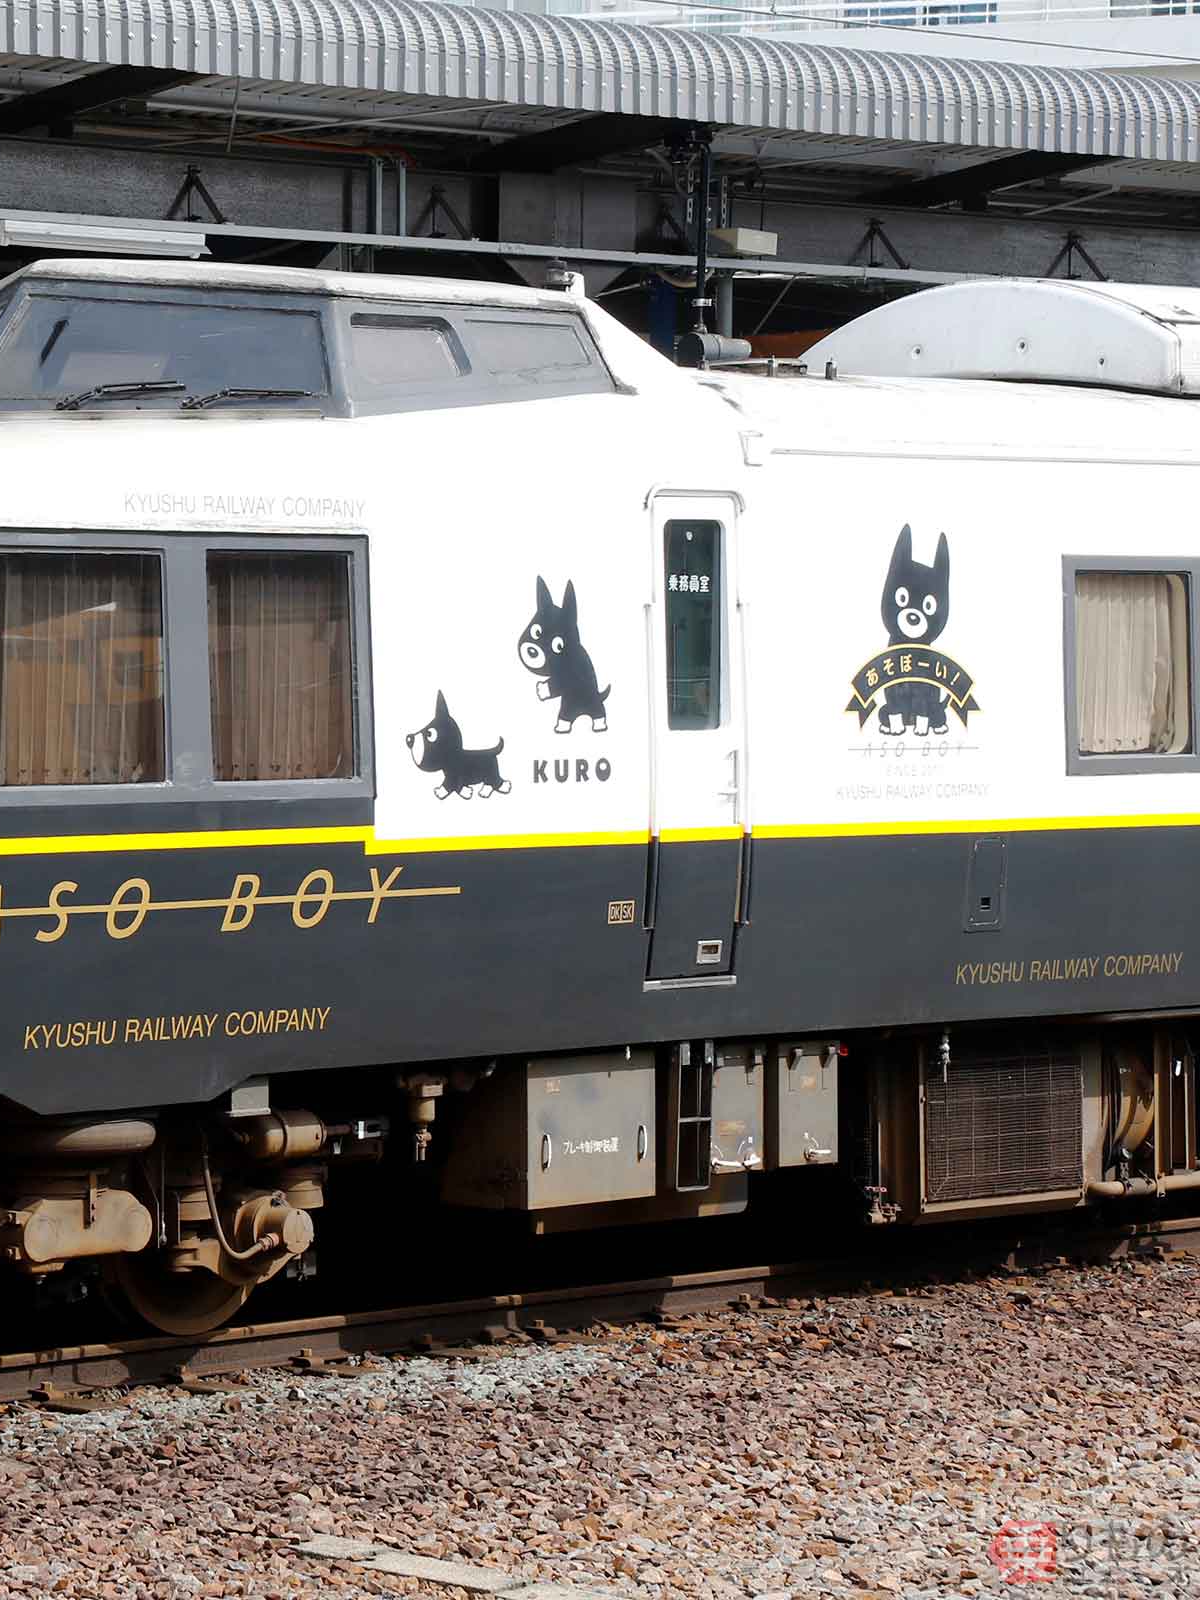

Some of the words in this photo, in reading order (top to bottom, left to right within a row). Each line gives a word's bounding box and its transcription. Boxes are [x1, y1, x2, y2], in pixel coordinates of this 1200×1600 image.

[124, 493, 196, 513] KYUSHU
[203, 495, 275, 516] RAILWAY
[282, 496, 367, 518] COMPANY
[533, 757, 611, 783] KURO
[220, 867, 403, 933] BOY
[956, 961, 1024, 985] KYUSHU
[1030, 957, 1099, 982] RAILWAY
[1103, 952, 1183, 977] COMPANY
[23, 1020, 116, 1049] KYUSHU
[124, 1014, 218, 1043] RAILWAY
[225, 1007, 331, 1036] COMPANY
